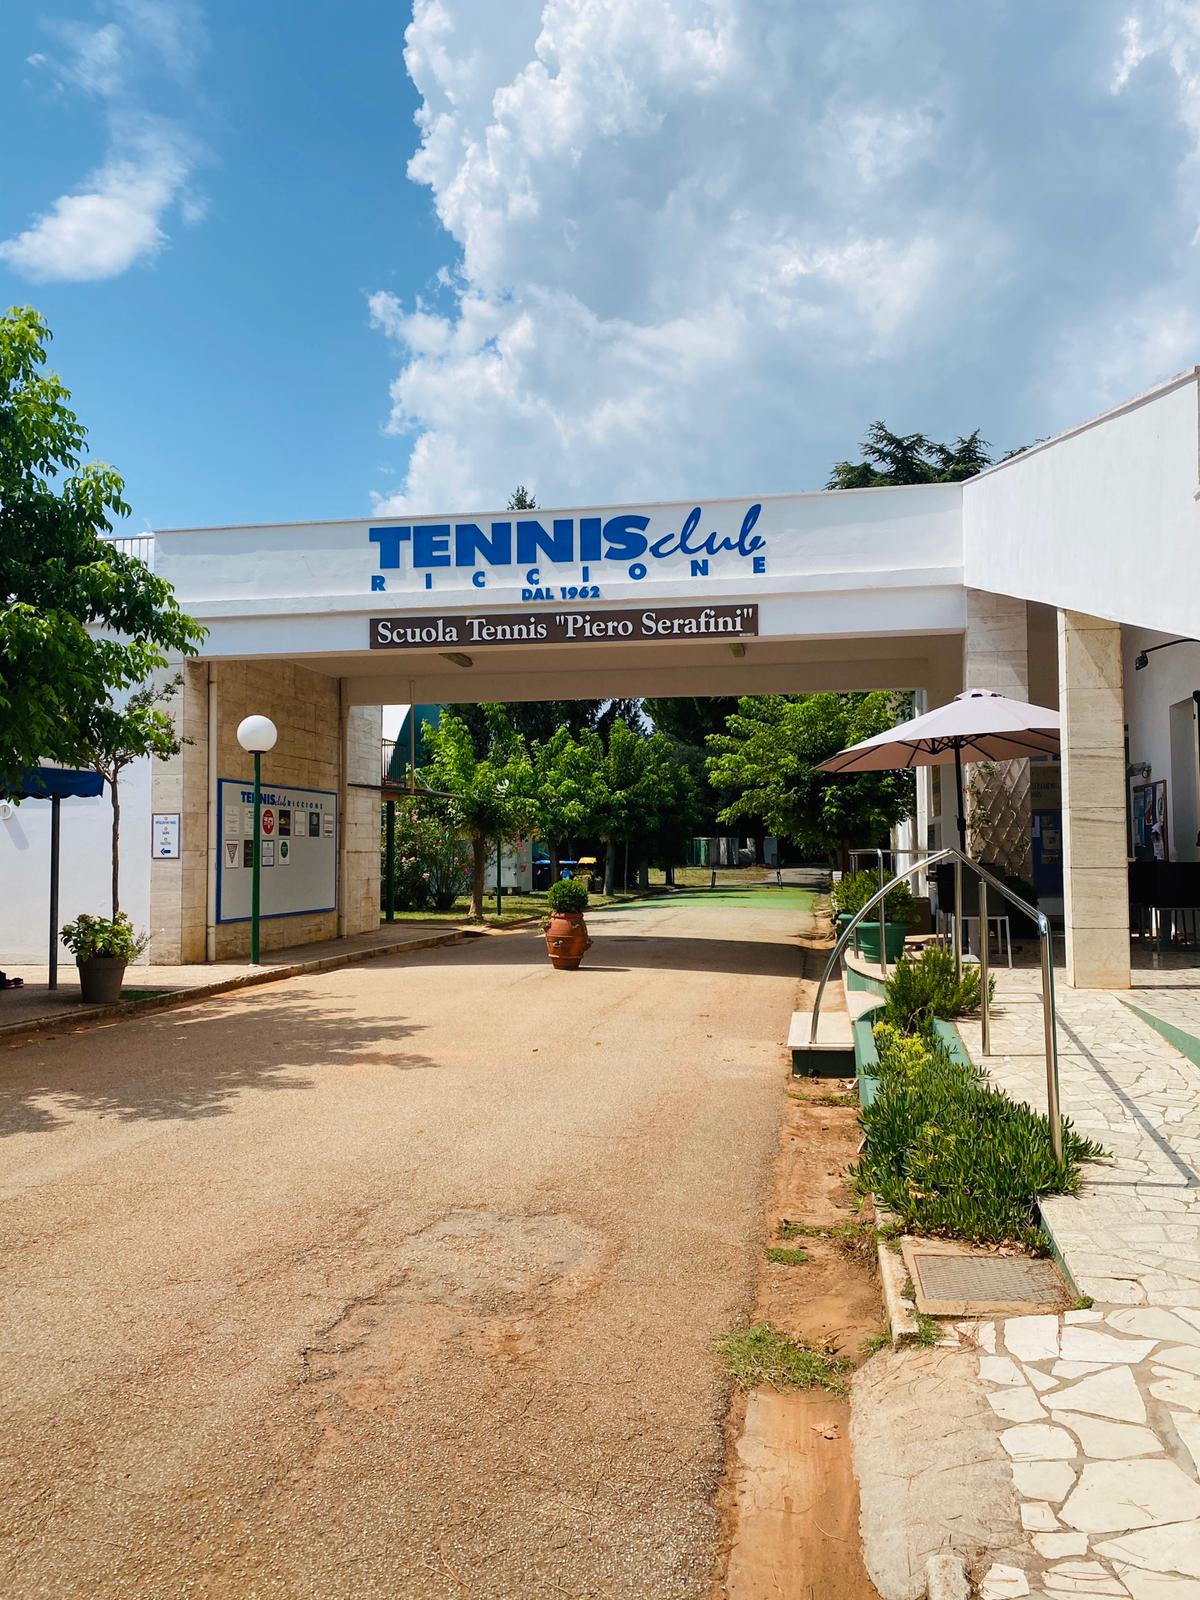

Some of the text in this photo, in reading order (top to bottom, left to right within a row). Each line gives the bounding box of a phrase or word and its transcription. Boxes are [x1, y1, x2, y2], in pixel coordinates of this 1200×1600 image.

[369, 503, 767, 569] TENNIS club
[371, 556, 766, 592] RICCIONE
[522, 586, 600, 601] DAL 1962
[377, 608, 753, 644] Scuola Tennis "Piero Serafini"
